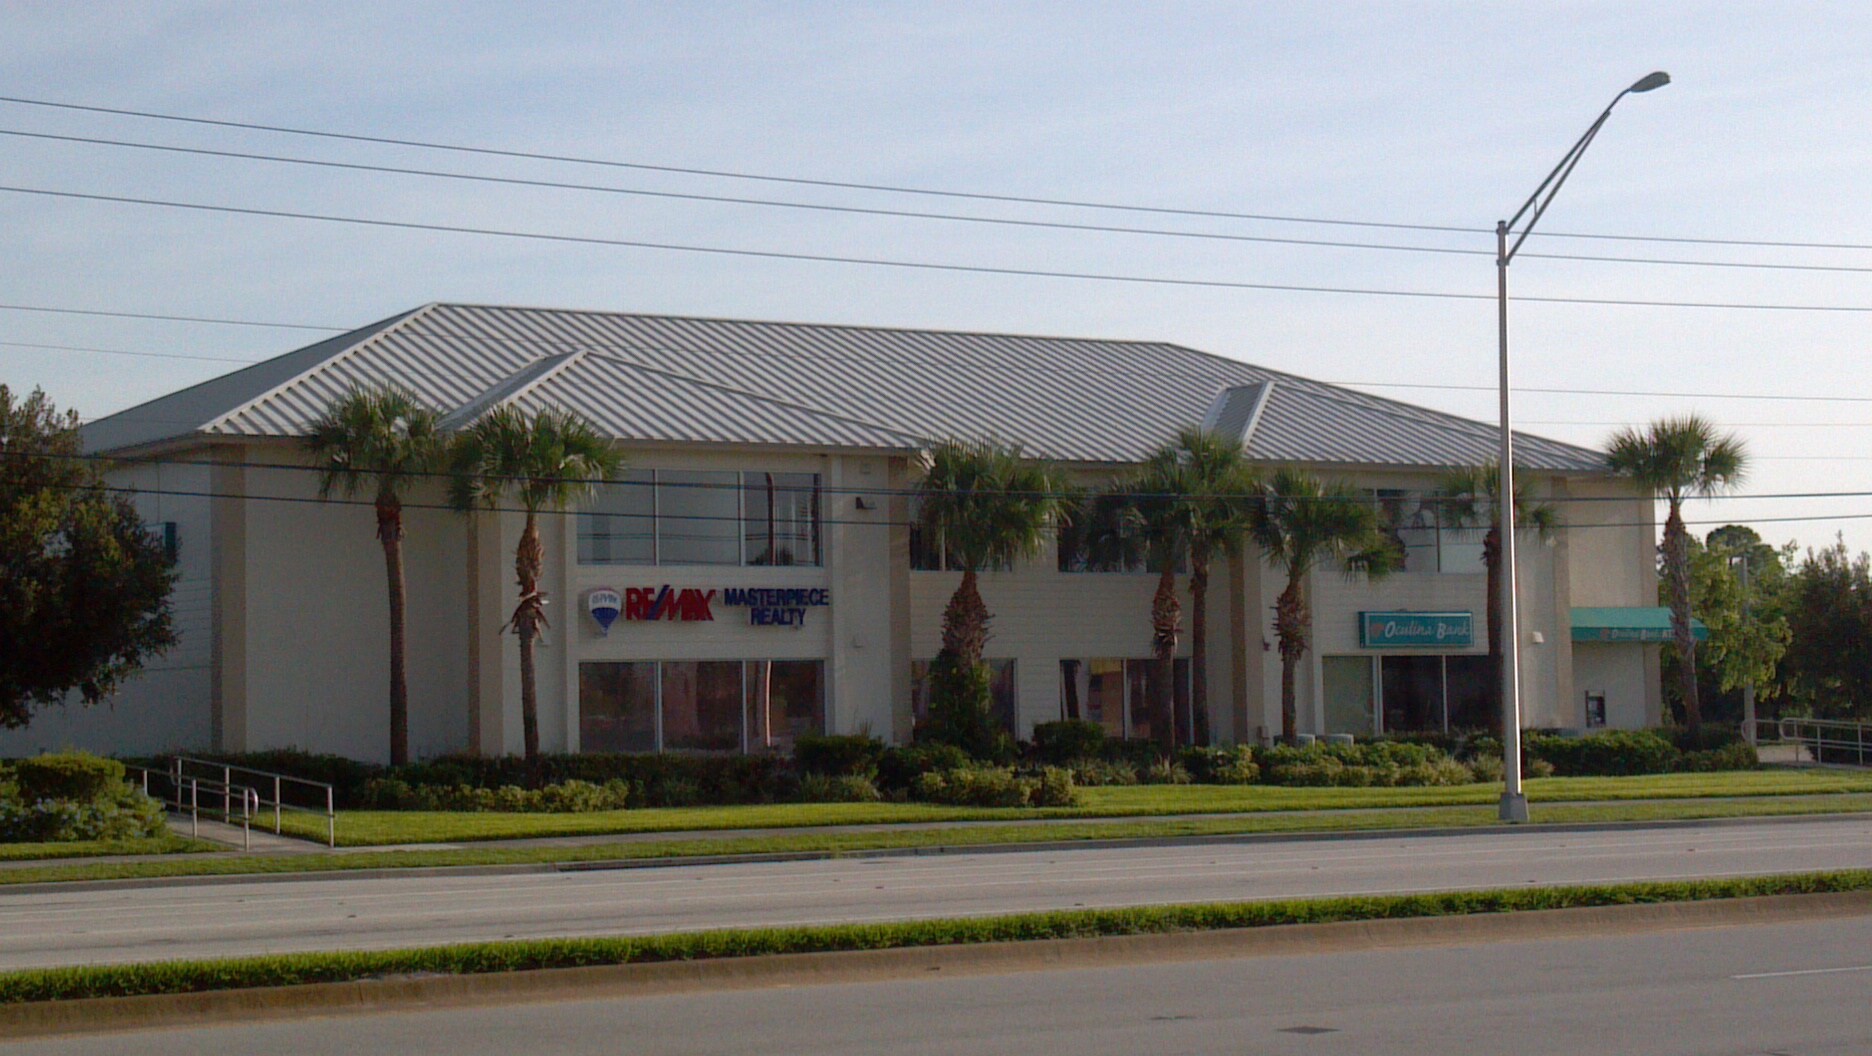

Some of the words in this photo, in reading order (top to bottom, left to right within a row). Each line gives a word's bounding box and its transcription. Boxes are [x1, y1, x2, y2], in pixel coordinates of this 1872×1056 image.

[724, 588, 829, 607] MASTERPIECE
[750, 608, 806, 626] REALTY
[1384, 621, 1431, 638] Oculina
[1437, 621, 1469, 639] Bank
